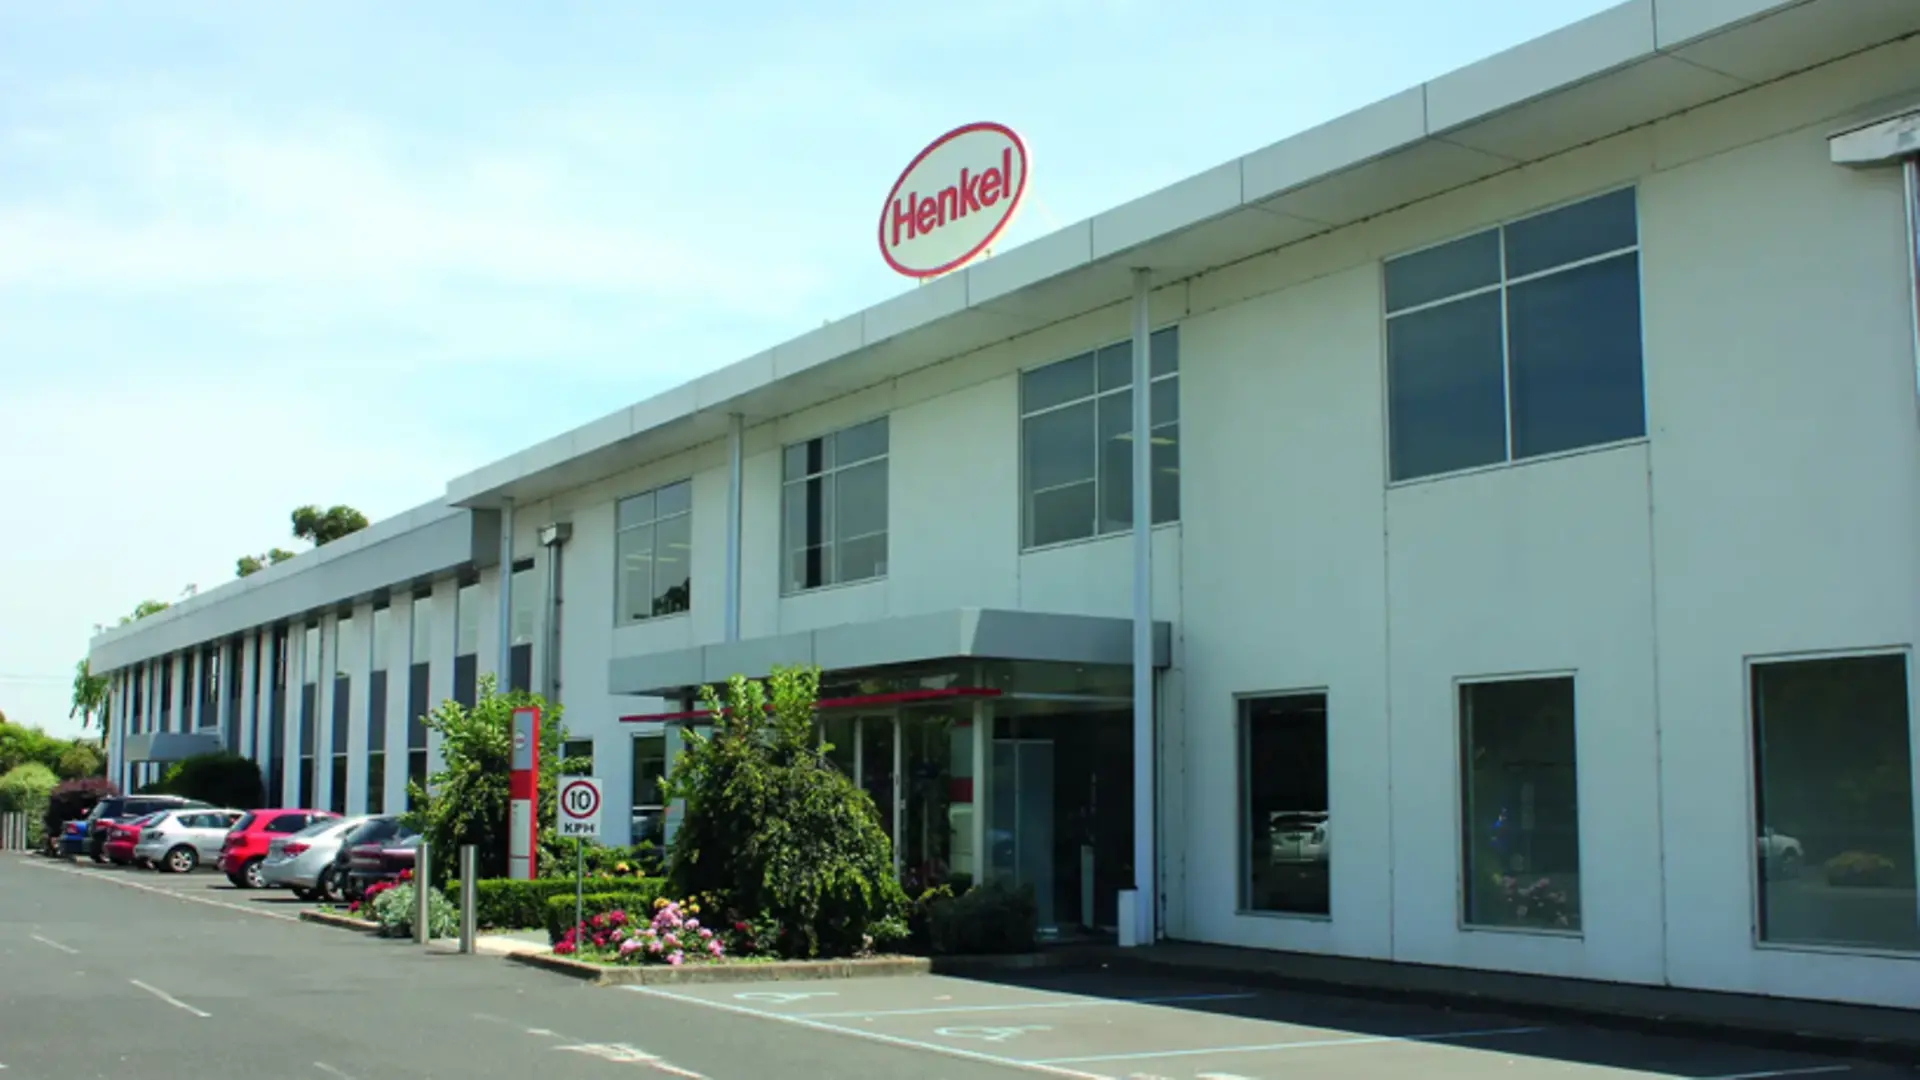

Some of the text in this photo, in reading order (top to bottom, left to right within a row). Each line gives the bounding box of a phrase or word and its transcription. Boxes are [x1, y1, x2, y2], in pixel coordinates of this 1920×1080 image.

[892, 147, 1012, 247] Henkel
[569, 790, 592, 810] 10
[564, 823, 595, 833] KPH
